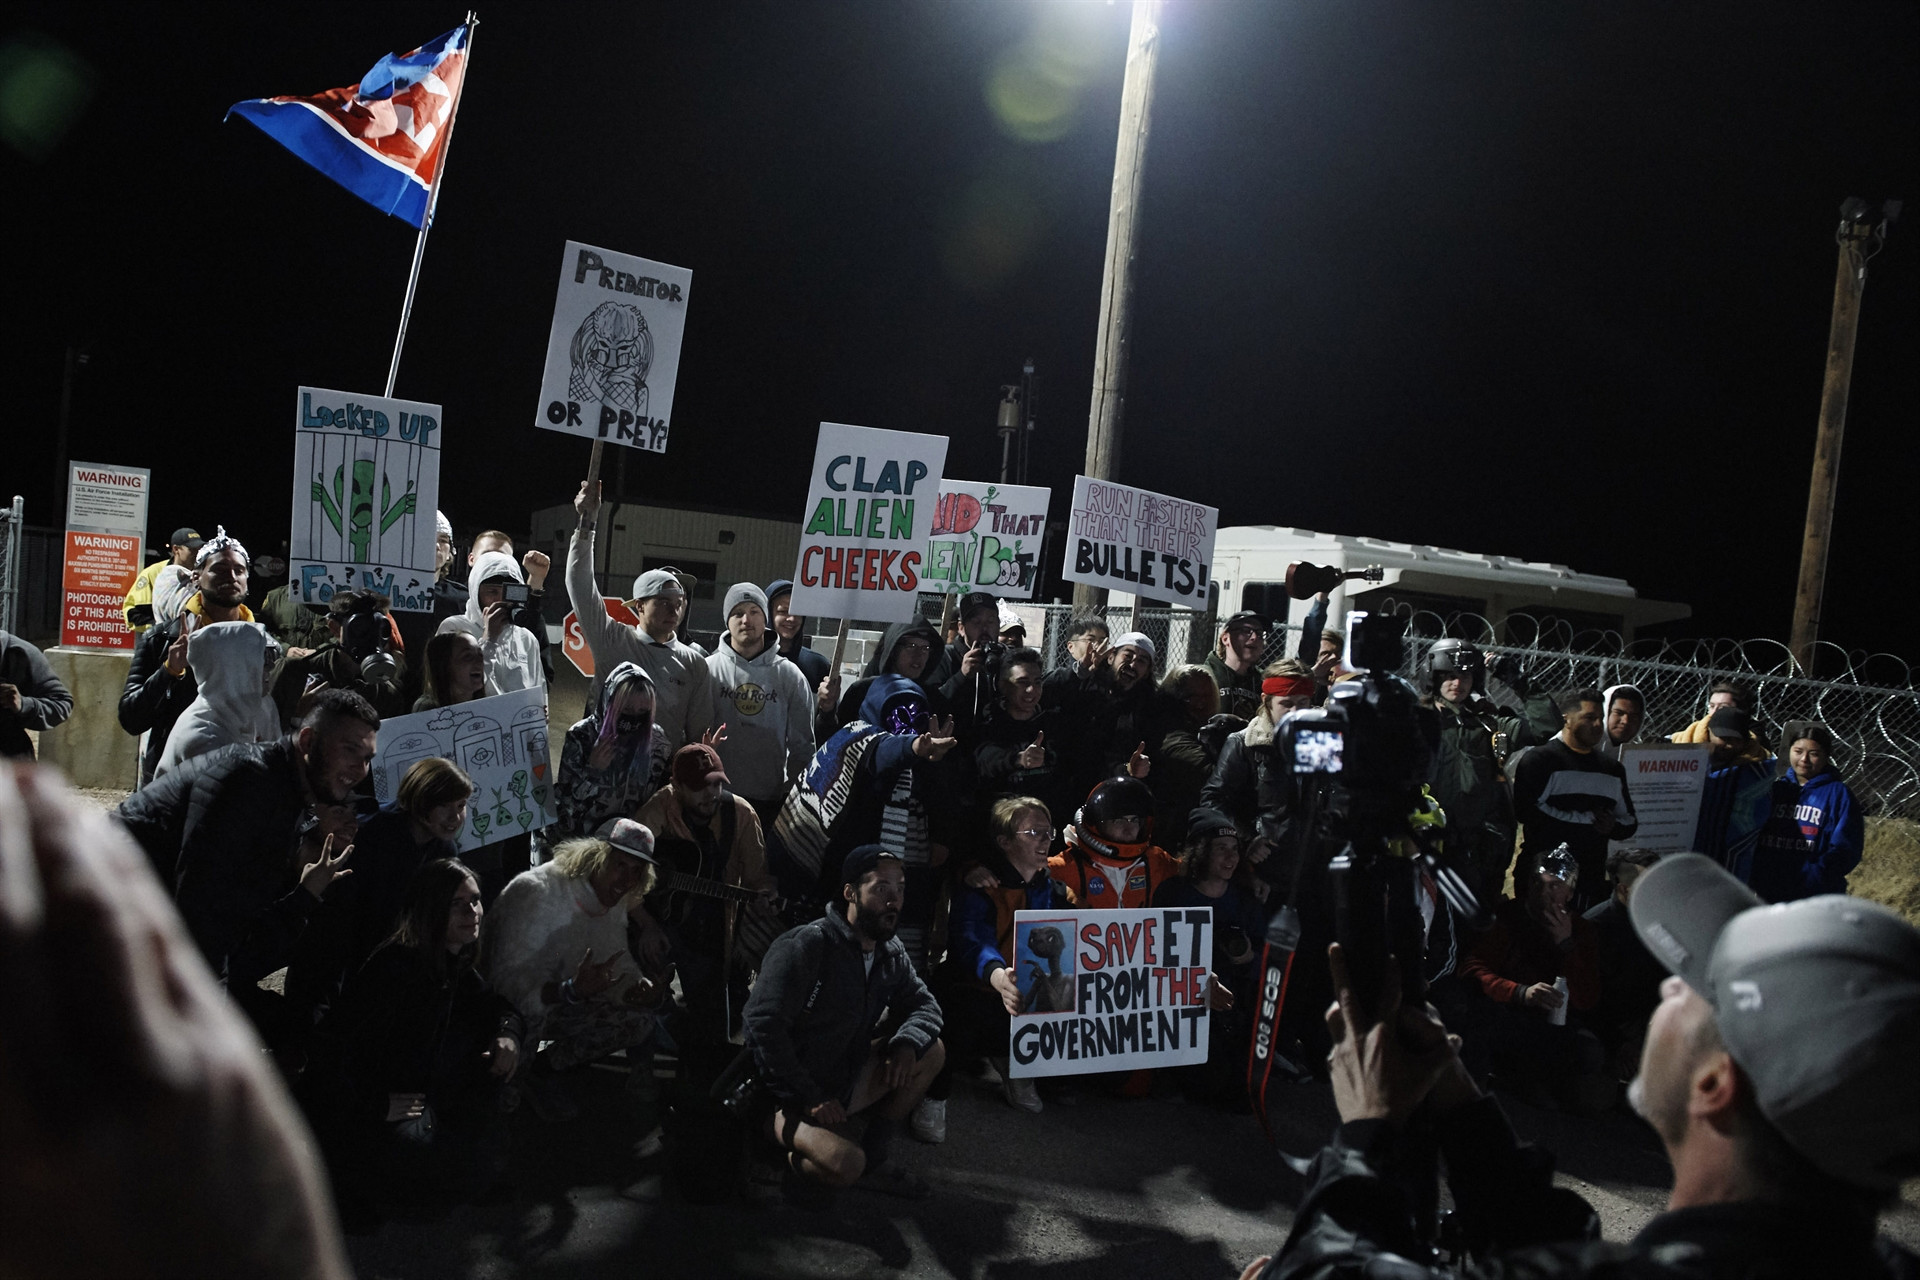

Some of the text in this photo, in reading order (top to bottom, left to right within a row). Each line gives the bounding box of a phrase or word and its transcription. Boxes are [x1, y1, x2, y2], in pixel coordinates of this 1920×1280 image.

[574, 249, 683, 303] PREDATOR
[399, 411, 438, 445] UP
[547, 400, 668, 450] OR PREY?
[77, 470, 141, 488] WARNING
[825, 455, 928, 495] CLAP
[804, 497, 915, 540] ALIEN
[986, 504, 1045, 536] THAT
[1086, 483, 1207, 537] RUN FASTER
[74, 536, 133, 551] WARNING!
[1073, 509, 1203, 563] THAN THEIR
[801, 545, 921, 592] CHEEKS
[1075, 538, 1208, 599] BULLETS!
[67, 619, 76, 630] IS
[69, 606, 124, 620] OF THIS ARE
[86, 636, 103, 644] USC
[109, 637, 122, 645] 795
[1638, 760, 1699, 773] WARNING
[1080, 910, 1211, 971] SAVE ET
[1077, 966, 1207, 1015] FROM THE
[1262, 966, 1281, 1020] EOS
[1012, 1007, 1207, 1066] GOVERNMENT
